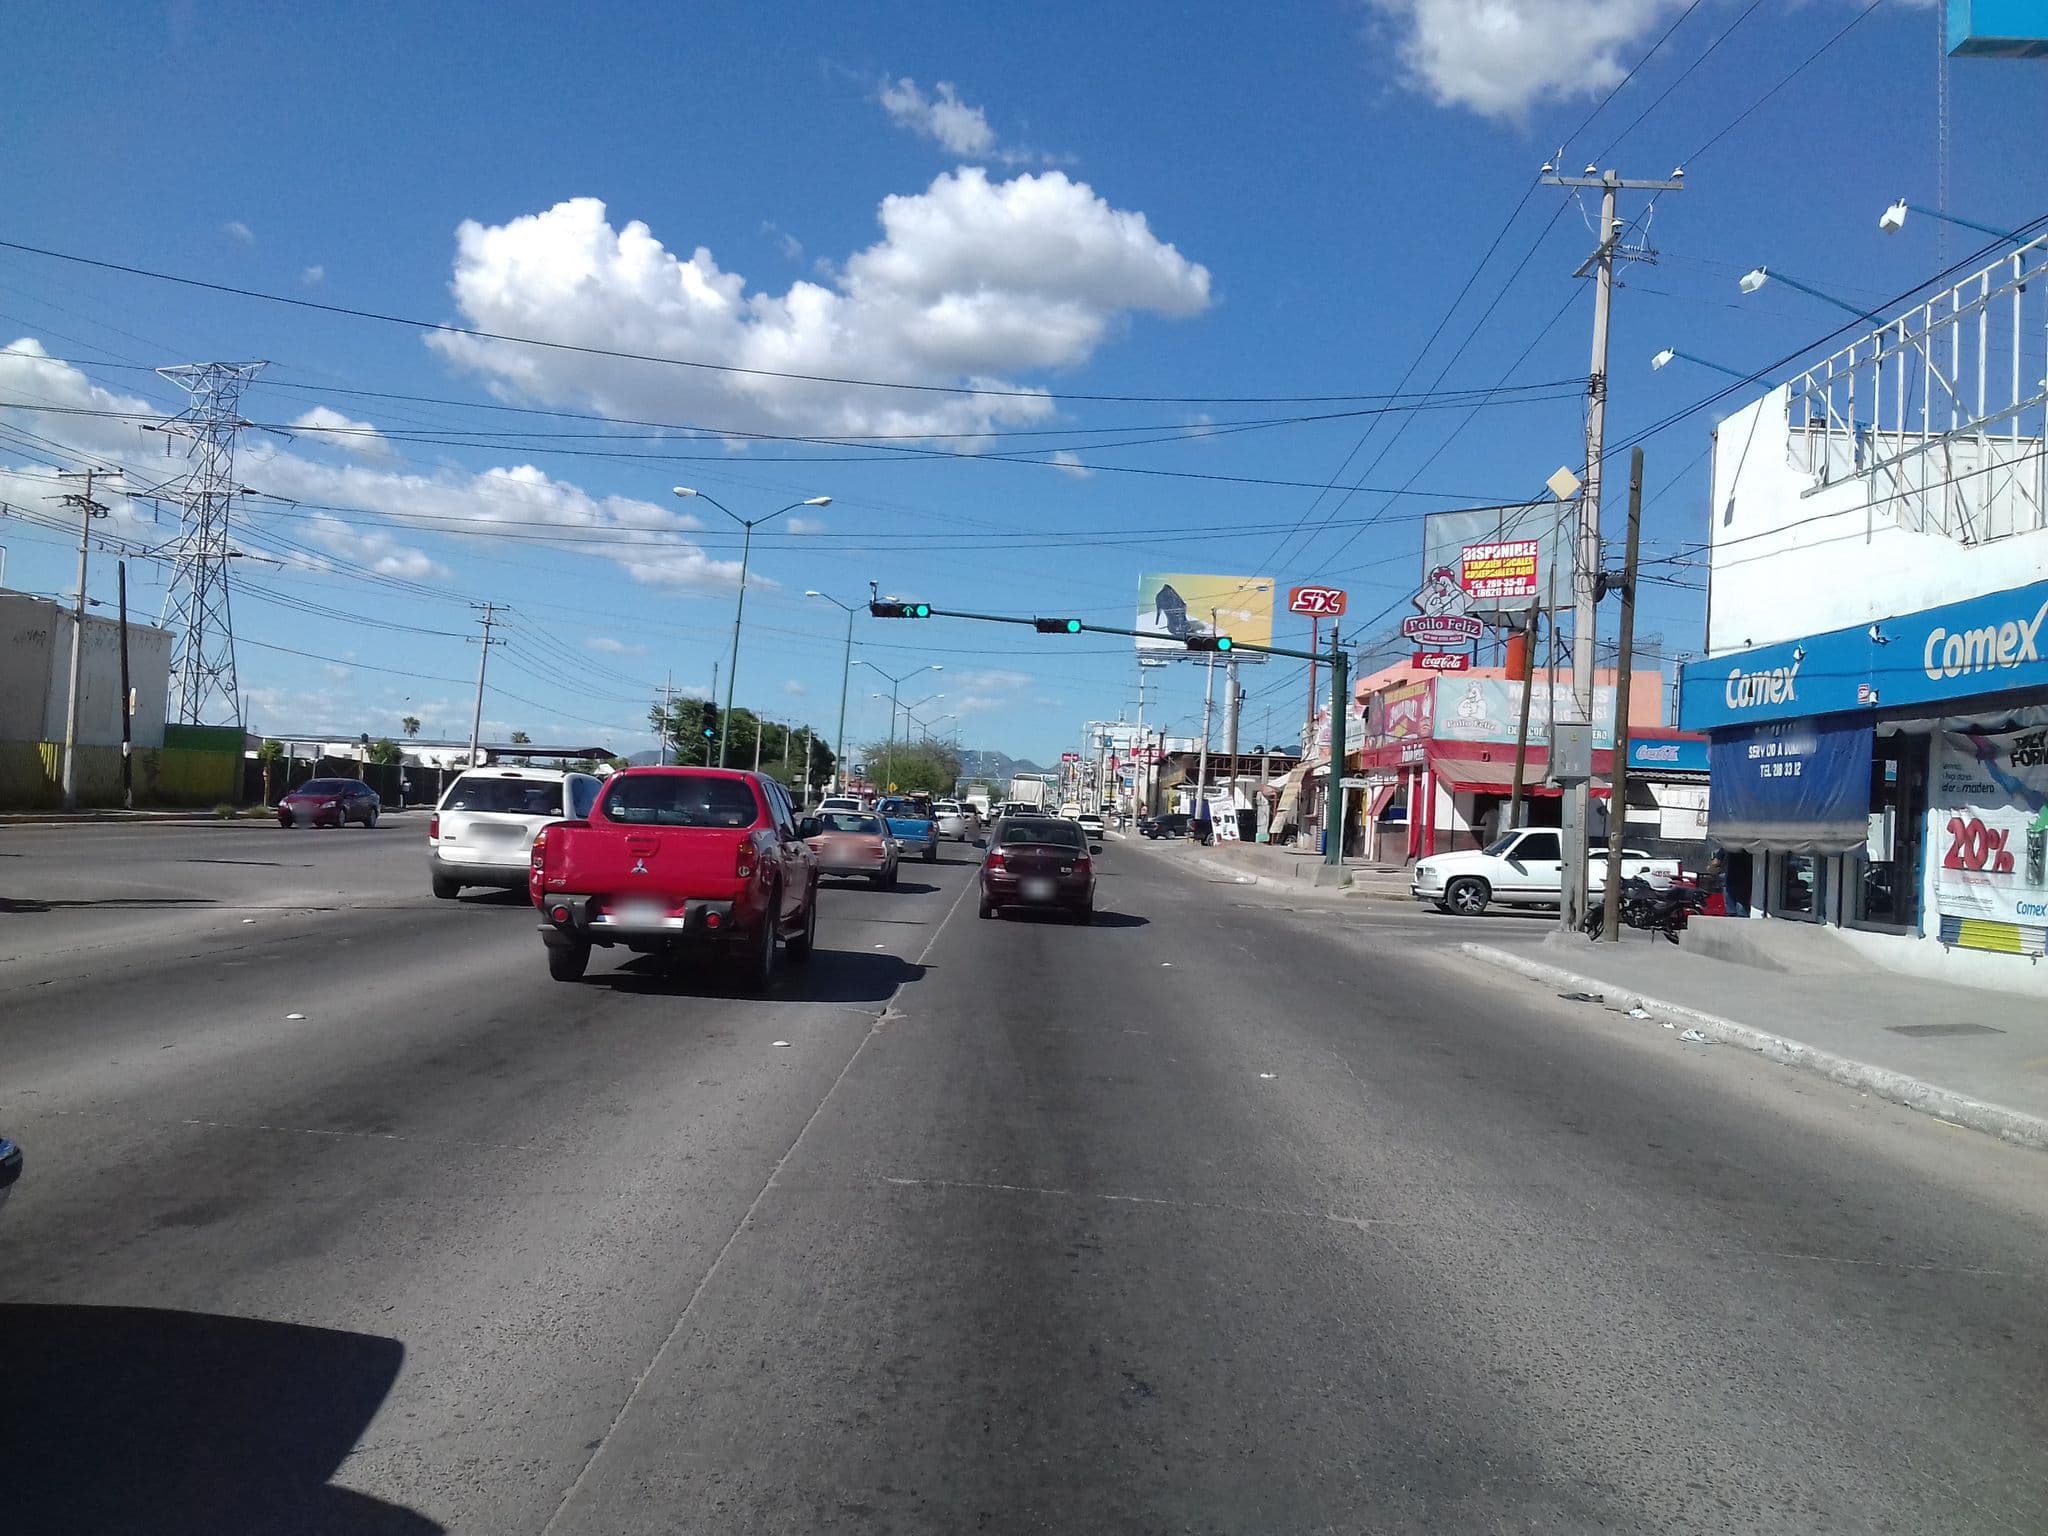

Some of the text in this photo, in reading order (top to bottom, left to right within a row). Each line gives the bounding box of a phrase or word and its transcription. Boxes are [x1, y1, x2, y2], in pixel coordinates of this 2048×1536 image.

[1462, 542, 1537, 561] DISPONIBLE
[1464, 562, 1469, 570] Y
[1502, 556, 1535, 568] LOCALES
[1409, 618, 1479, 634] Pollo Feliz
[1924, 602, 2048, 681] Comex
[1726, 663, 1800, 709] Comex
[1748, 743, 1777, 760] SERVCIO
[1760, 764, 1772, 778] TEL
[1944, 816, 2015, 873] 20%
[2016, 900, 2047, 917] Comex
